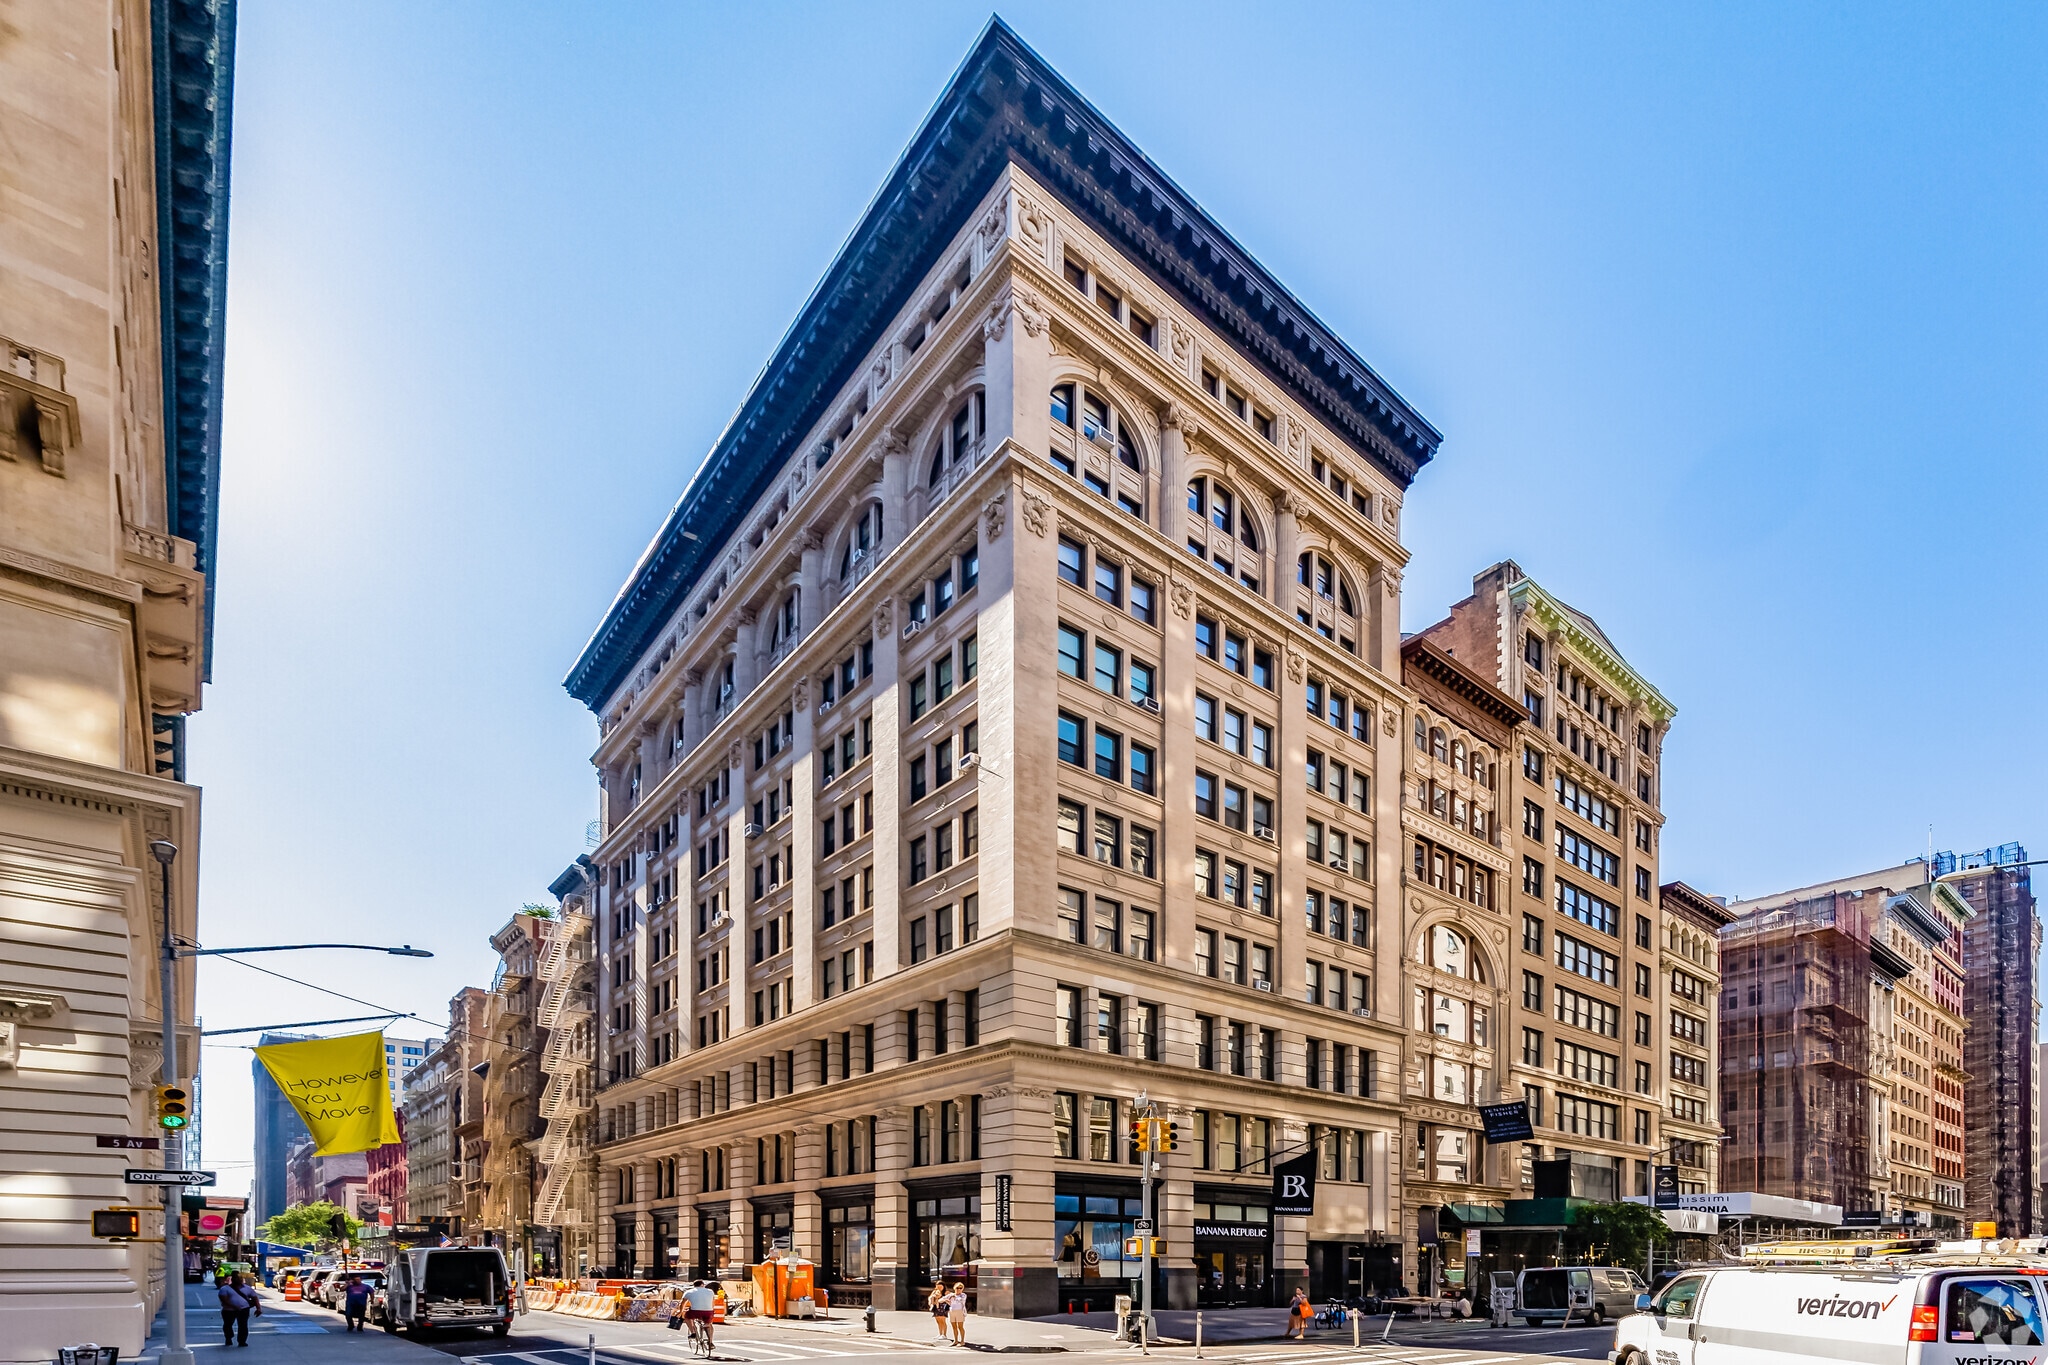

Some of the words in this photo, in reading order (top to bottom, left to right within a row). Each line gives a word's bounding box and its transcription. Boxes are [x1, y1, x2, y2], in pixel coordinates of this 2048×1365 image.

[286, 1067, 383, 1091] However
[293, 1092, 342, 1105] You
[305, 1105, 375, 1121] Move.
[126, 1140, 143, 1148] Av
[1282, 1175, 1309, 1198] BR
[1195, 1226, 1230, 1236] BANANA
[1230, 1227, 1267, 1238] REPUBLIC
[1797, 1293, 1881, 1319] verizon
